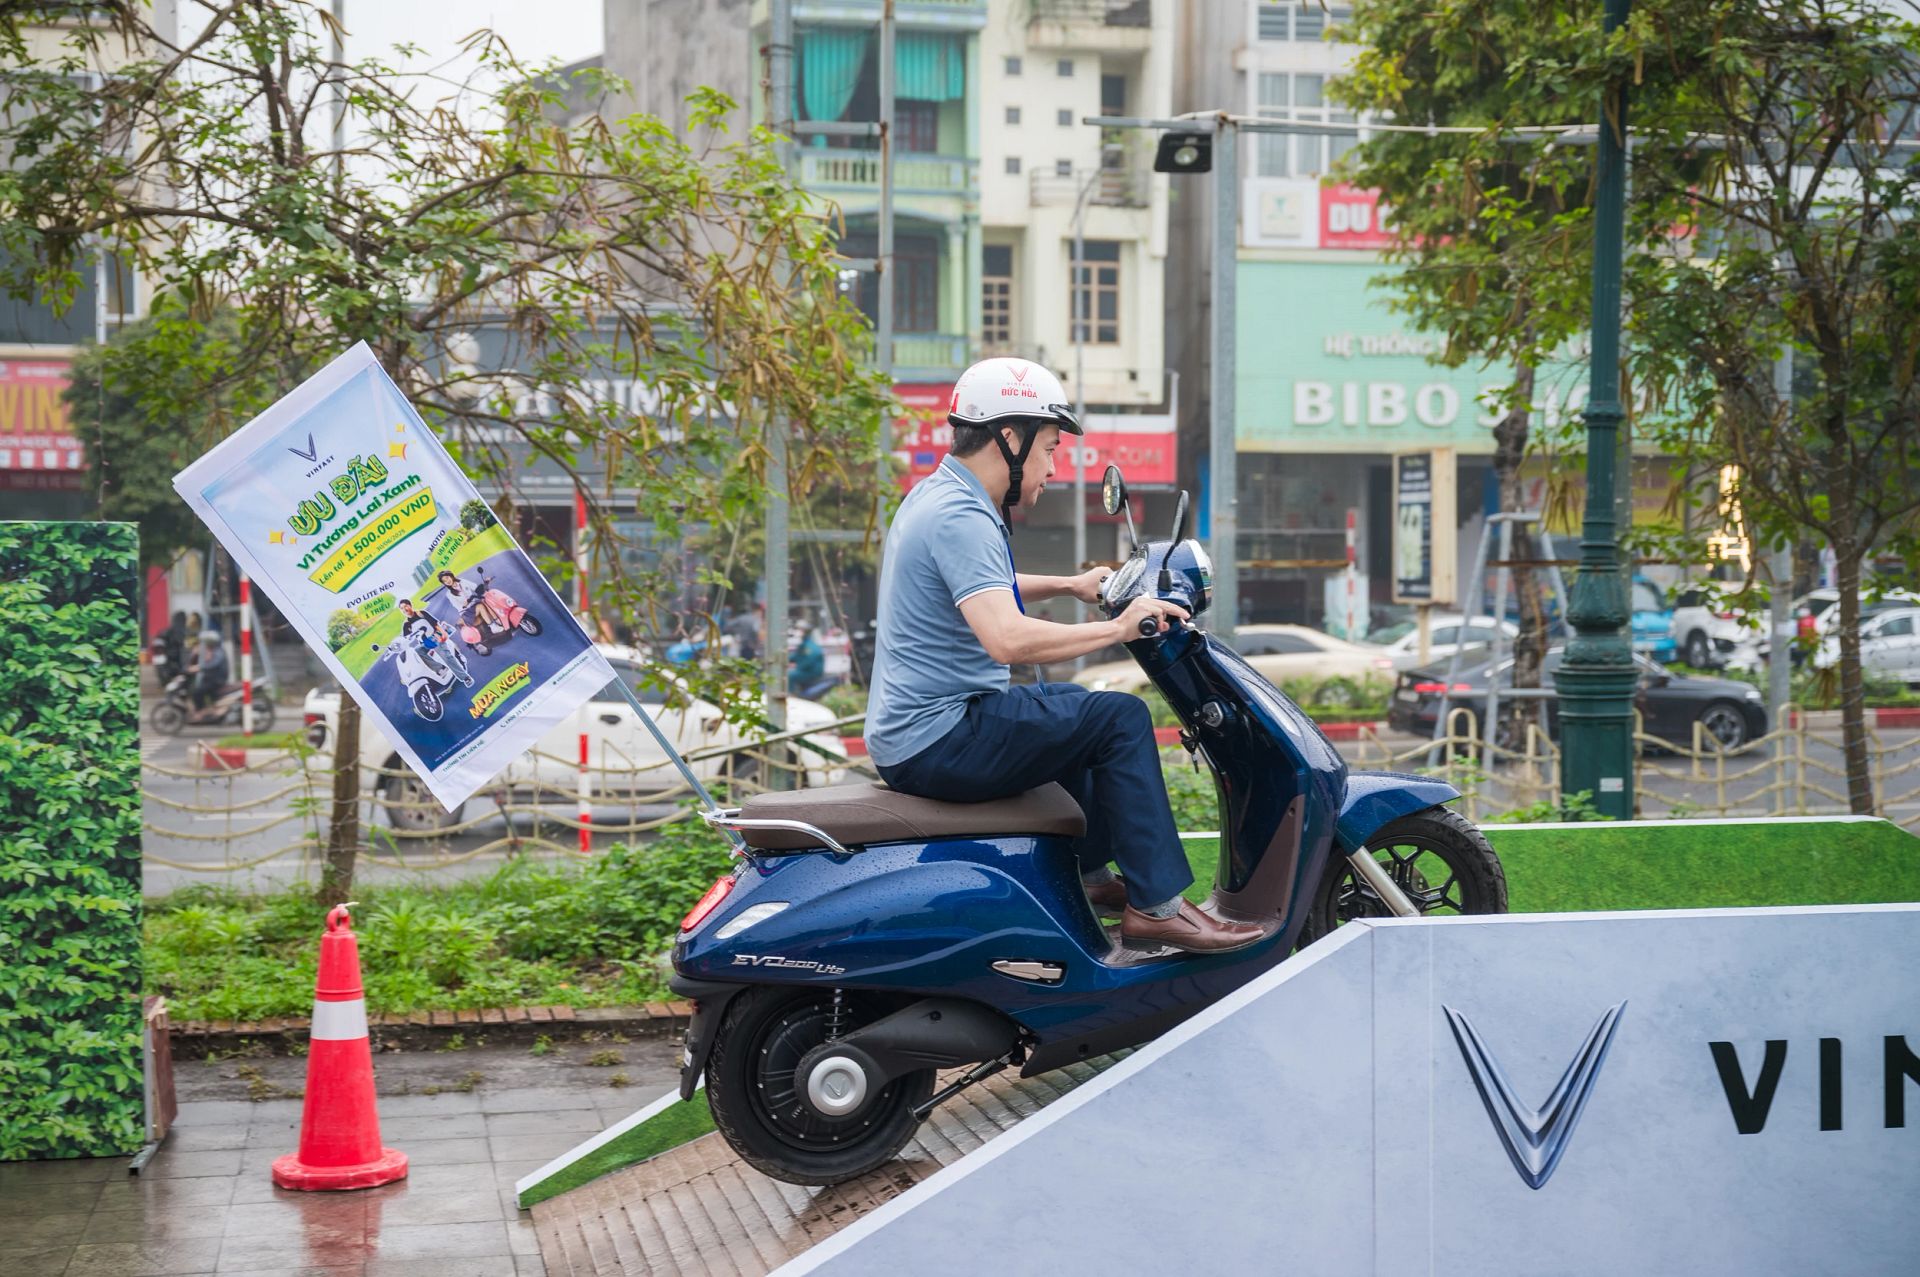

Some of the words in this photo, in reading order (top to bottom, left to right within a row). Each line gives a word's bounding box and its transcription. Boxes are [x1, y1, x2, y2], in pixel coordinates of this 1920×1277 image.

[1328, 202, 1371, 233] DU
[1001, 387, 1019, 397] ĐỨC
[1293, 380, 1460, 428] BIBO
[306, 455, 335, 478] VINFAST
[287, 491, 336, 535] ƯU
[329, 454, 389, 506] ĐÃI
[312, 517, 359, 555] Tương
[356, 496, 382, 519] Lai
[380, 473, 421, 503] Xanh
[318, 570, 334, 585] Lên
[344, 514, 401, 562] 1.500.000
[401, 494, 431, 517] VND
[428, 529, 446, 553] MOTIO
[346, 597, 362, 609] EVO
[362, 590, 378, 602] LITE
[379, 581, 395, 594] NEO
[468, 690, 498, 720] MUA
[496, 661, 530, 695] NGAY
[815, 964, 845, 975] Lite
